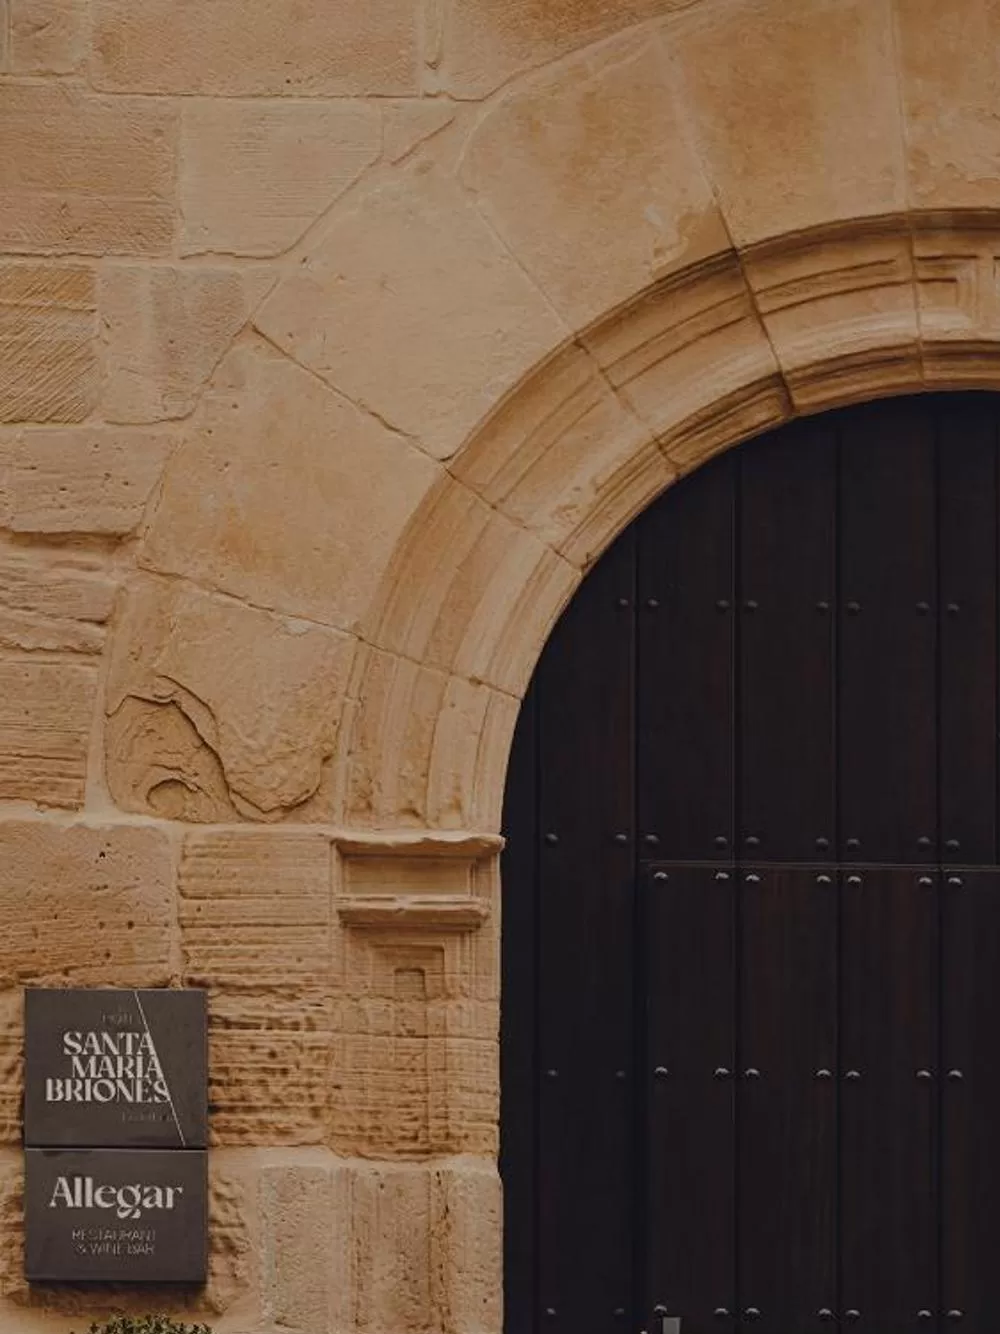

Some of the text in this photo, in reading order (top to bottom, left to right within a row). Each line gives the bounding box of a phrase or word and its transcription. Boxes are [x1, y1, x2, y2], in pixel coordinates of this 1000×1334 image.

[63, 1031, 157, 1055] SANTA
[71, 1055, 165, 1079] MARIA
[45, 1078, 171, 1103] BRIONES
[49, 1176, 184, 1219] Allegar
